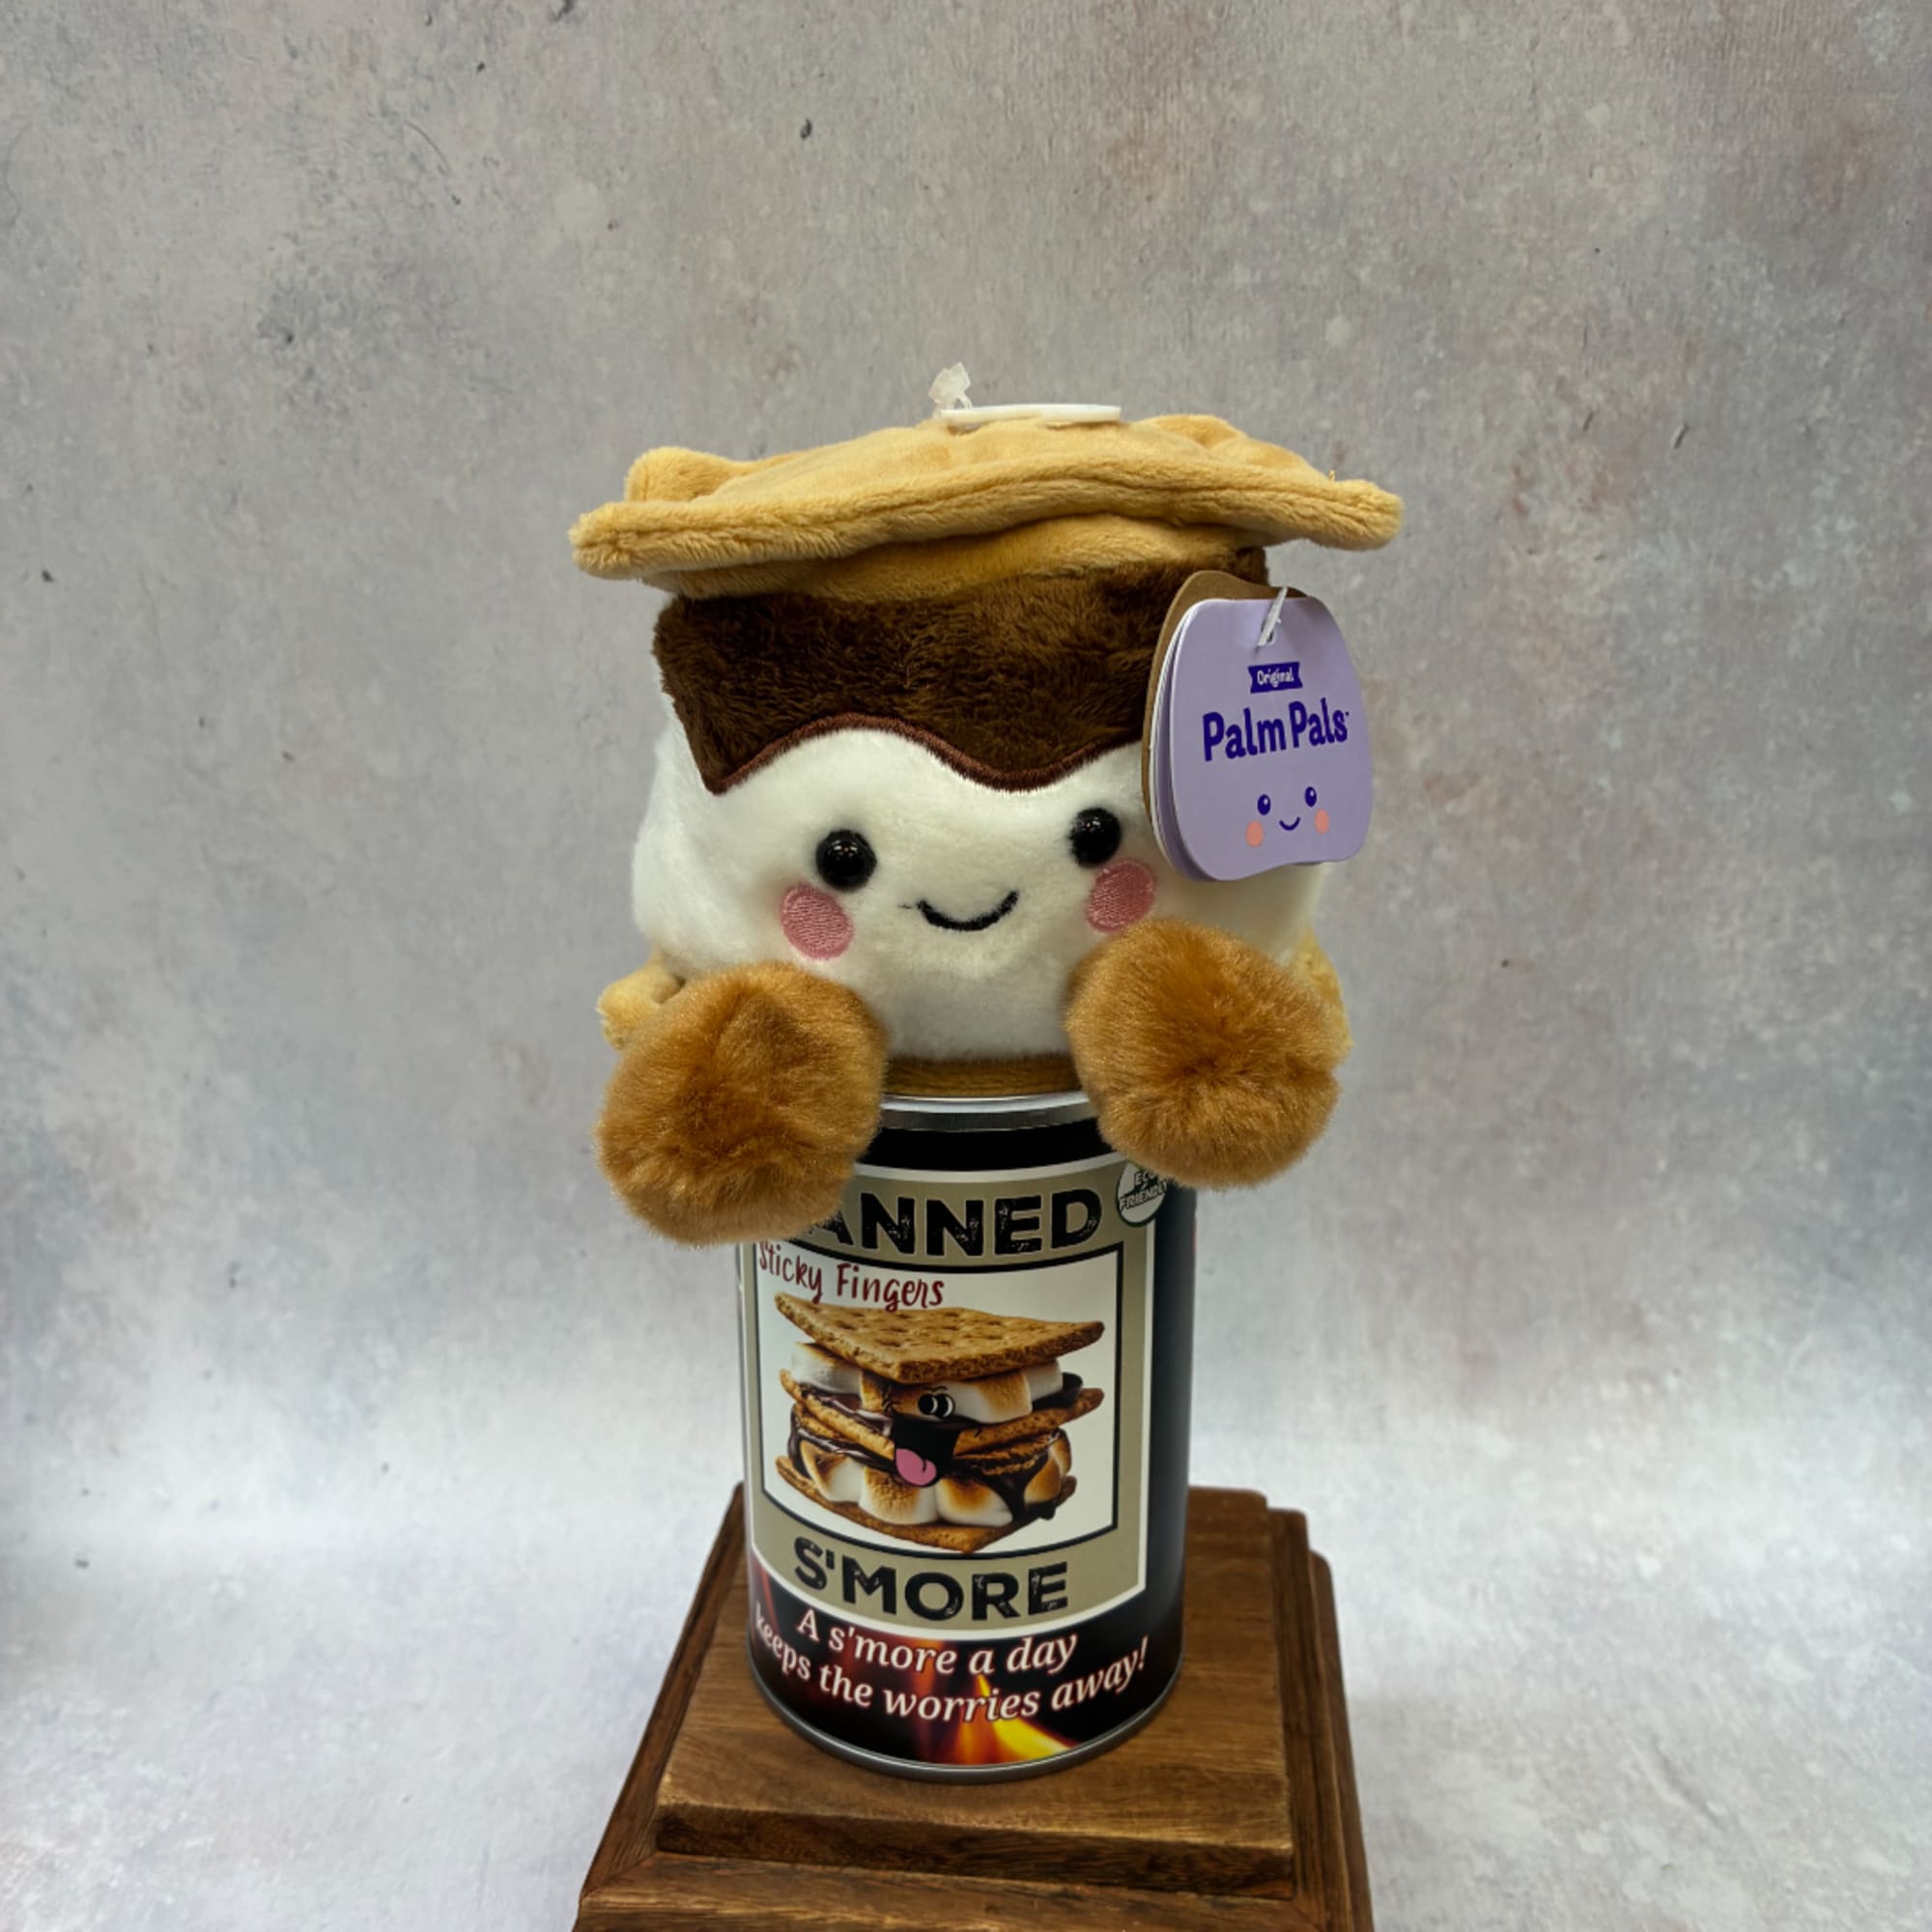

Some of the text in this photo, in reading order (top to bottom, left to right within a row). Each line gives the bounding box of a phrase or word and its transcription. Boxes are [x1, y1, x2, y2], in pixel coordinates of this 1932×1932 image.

[1257, 667, 1294, 688] Original
[1203, 696, 1349, 762] Palm Pals
[759, 1241, 945, 1313] Sticky Fingers
[794, 1536, 1069, 1622] S'MORE
[755, 1600, 1150, 1722] keeps the worries away!
[796, 1608, 1078, 1675] A s'more a day
